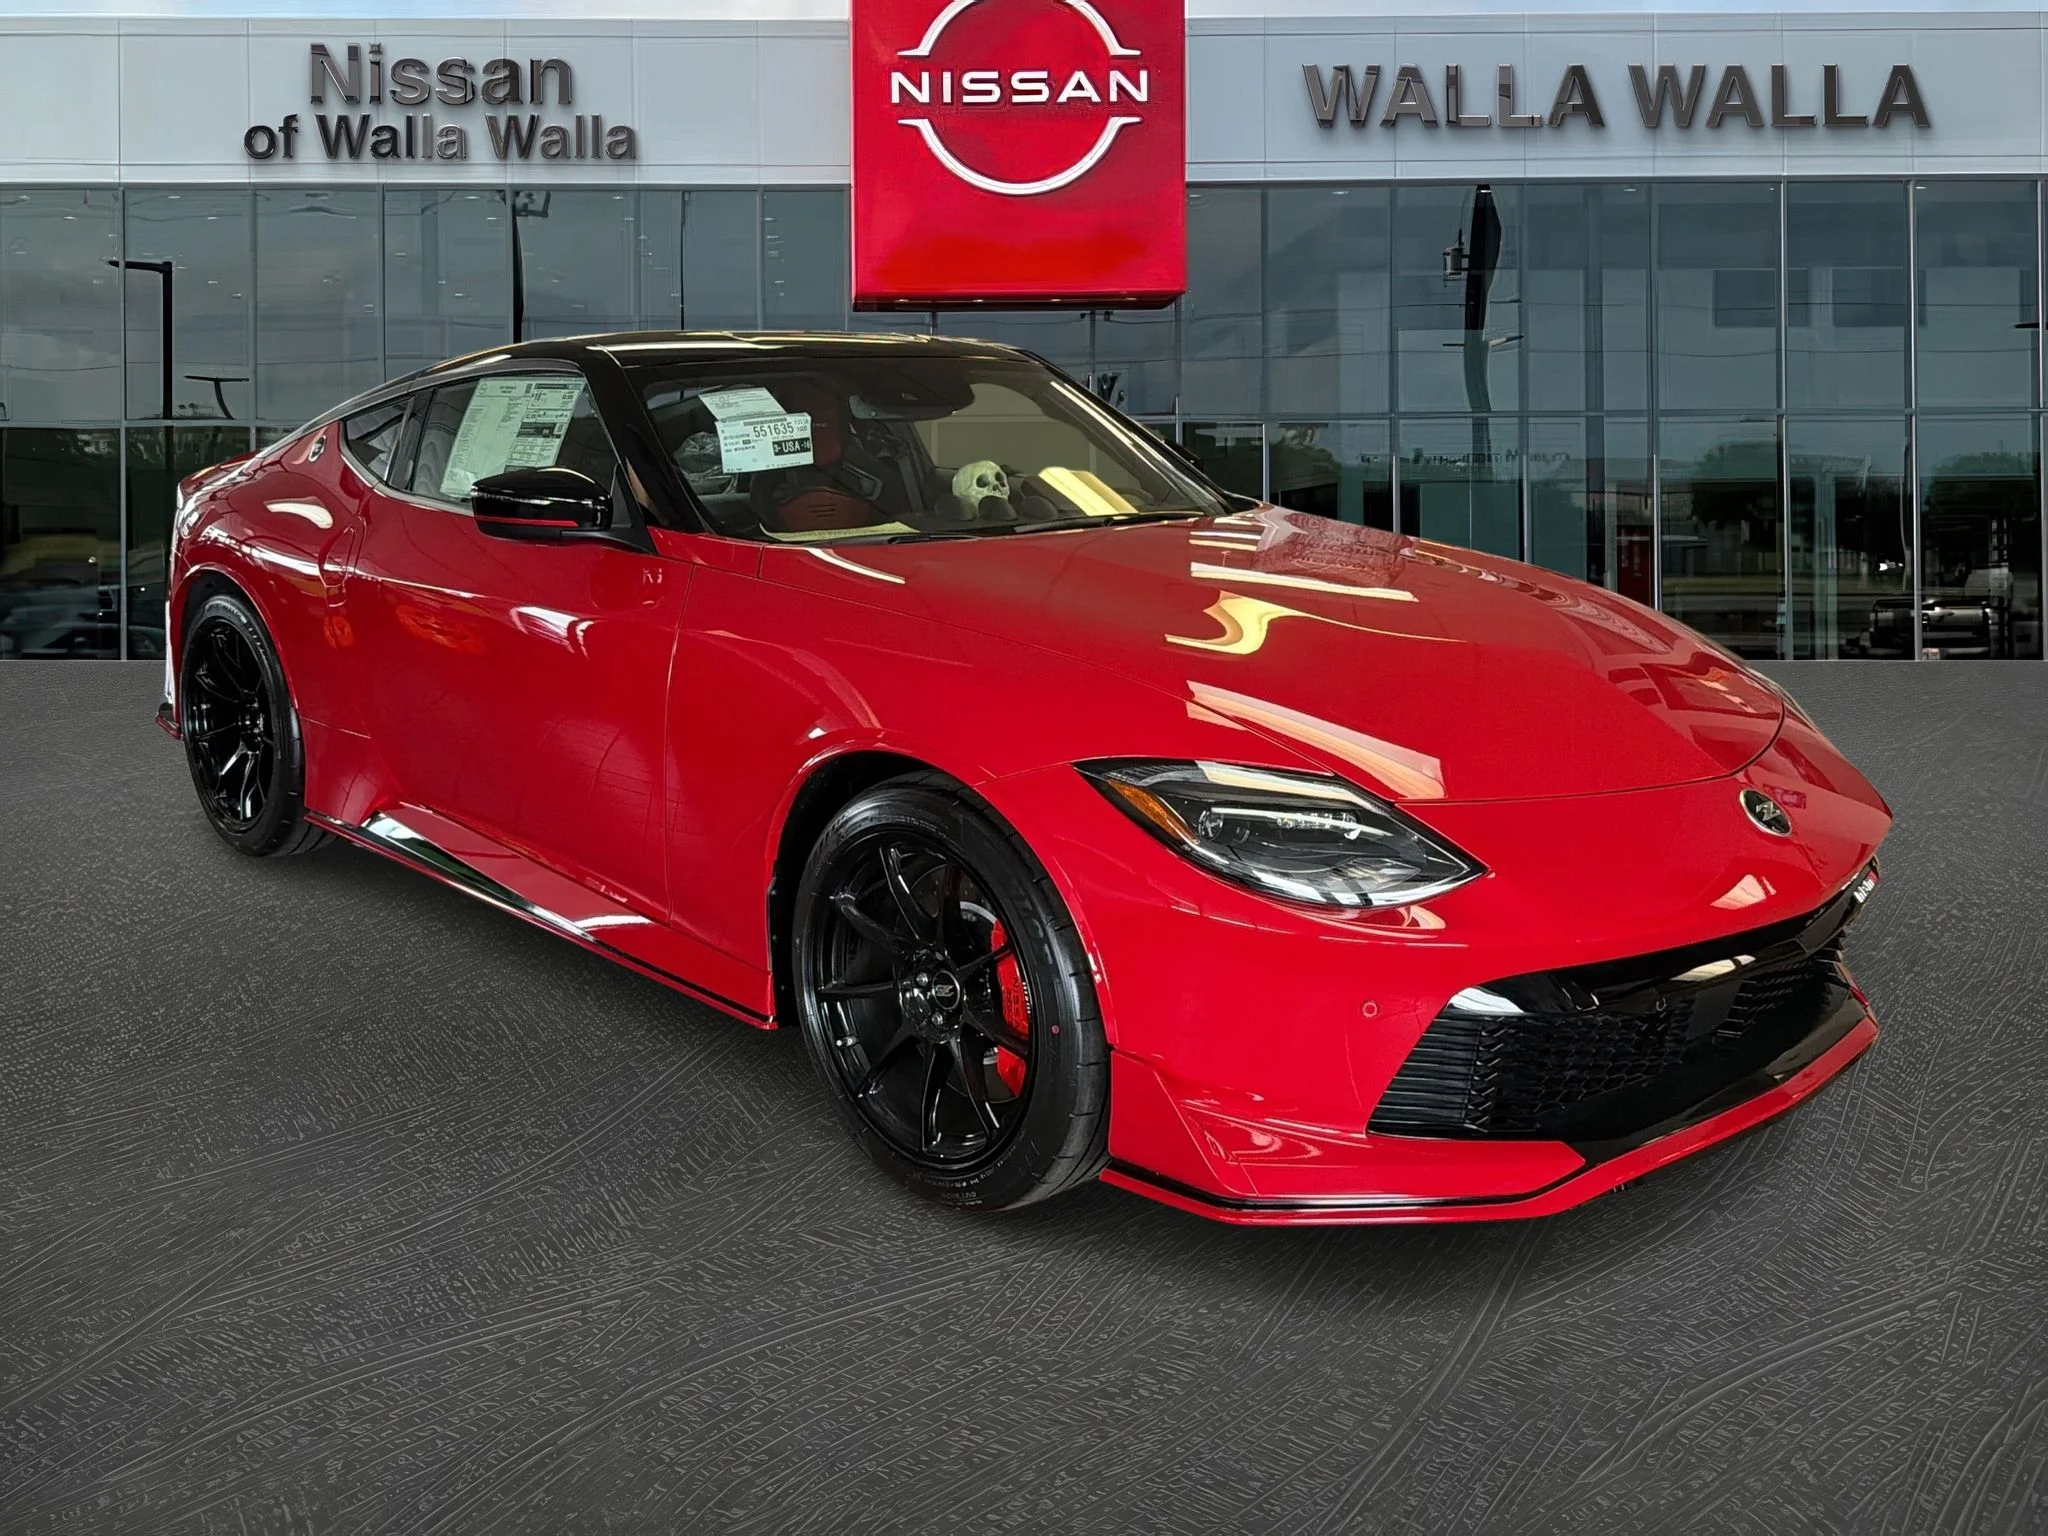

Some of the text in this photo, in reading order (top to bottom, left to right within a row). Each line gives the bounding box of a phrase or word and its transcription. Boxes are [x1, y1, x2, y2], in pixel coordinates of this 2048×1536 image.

[310, 42, 572, 104] Nissan
[891, 70, 1148, 103] NISSAN
[1302, 63, 1931, 127] WALLA WALLA
[243, 112, 636, 159] of Walla Walla
[753, 422, 794, 438] 551635
[782, 440, 800, 453] USA
